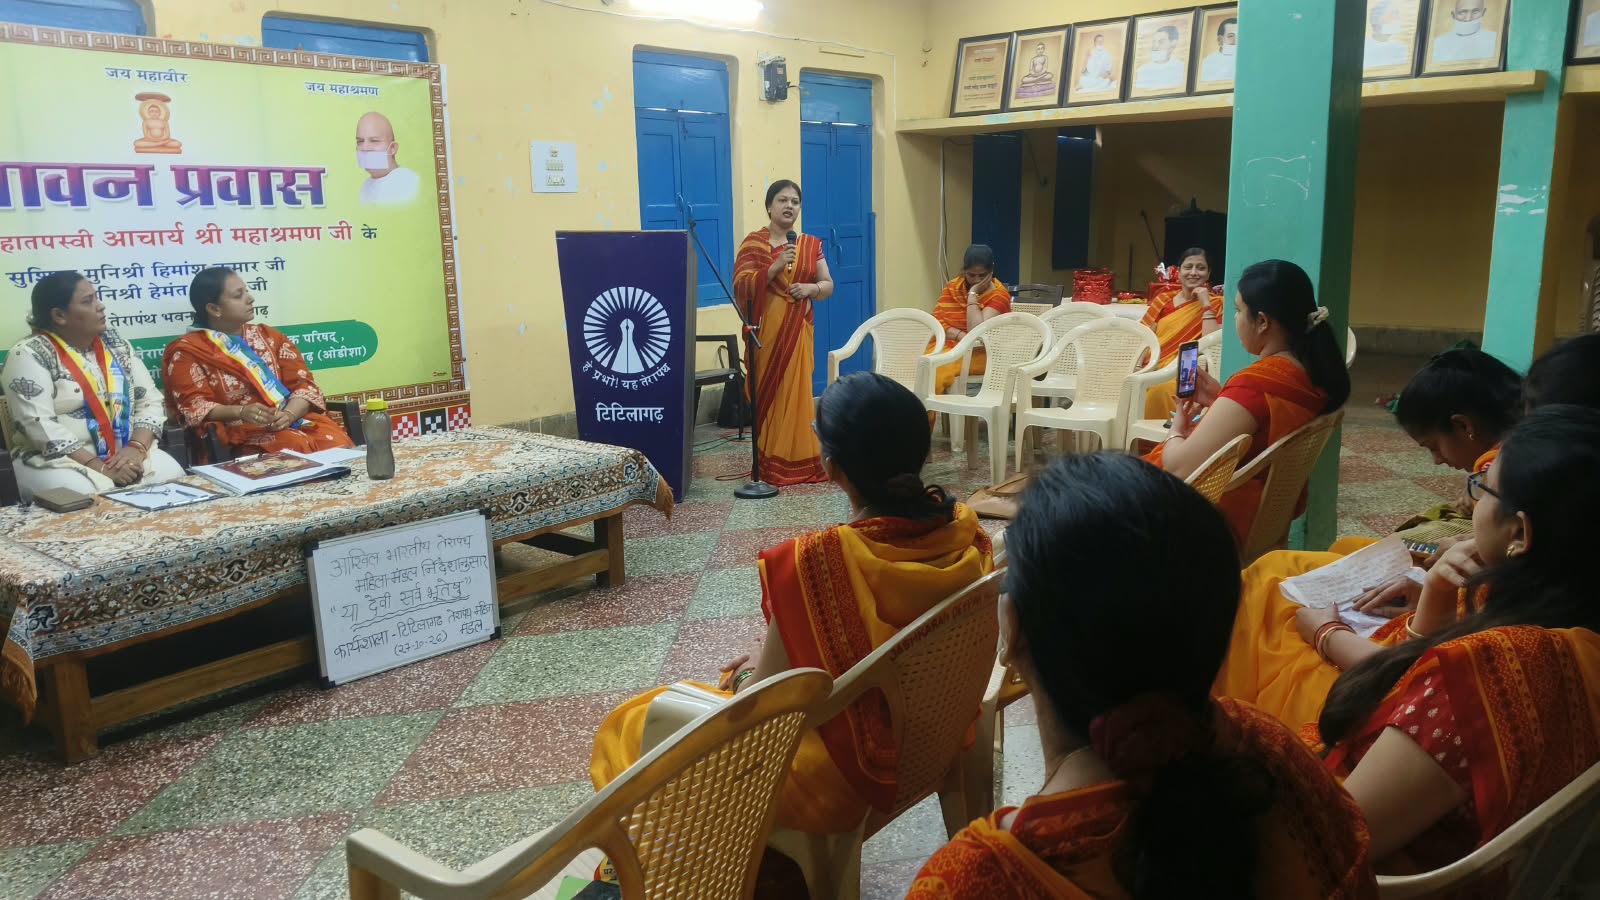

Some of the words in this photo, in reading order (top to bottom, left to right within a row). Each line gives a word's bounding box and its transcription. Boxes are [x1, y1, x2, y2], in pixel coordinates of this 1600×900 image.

[105, 67, 130, 79] जय
[136, 68, 188, 82] महावीर
[305, 81, 325, 92] जय
[329, 83, 379, 96] महाश्रमण
[169, 163, 327, 208] प्रवास
[0, 229, 94, 253] हातपस्वी
[103, 222, 185, 248] आचार्य
[195, 224, 223, 245] श्री
[230, 226, 322, 245] महाश्रमण
[328, 220, 353, 241] जी
[361, 224, 378, 240] के
[83, 263, 145, 284] मुनिश्री
[151, 261, 207, 279] हिमांश
[264, 256, 286, 272] जी
[96, 284, 142, 302] निश्री
[148, 282, 188, 301] हेमंत
[246, 276, 268, 292] जी
[108, 310, 158, 327] तेरापंथ
[317, 344, 368, 362] (ओडीशा)
[582, 360, 593, 373] हे
[592, 369, 619, 389] प्रभो!
[621, 379, 639, 391] यह
[640, 363, 672, 386] तेरापंथ
[595, 402, 665, 424] टिटिलागढ़
[386, 536, 430, 562] भारतीय
[355, 571, 388, 593] महिला
[390, 567, 418, 583] मंडल
[364, 591, 392, 616] देवी
[400, 581, 421, 606] सर्व
